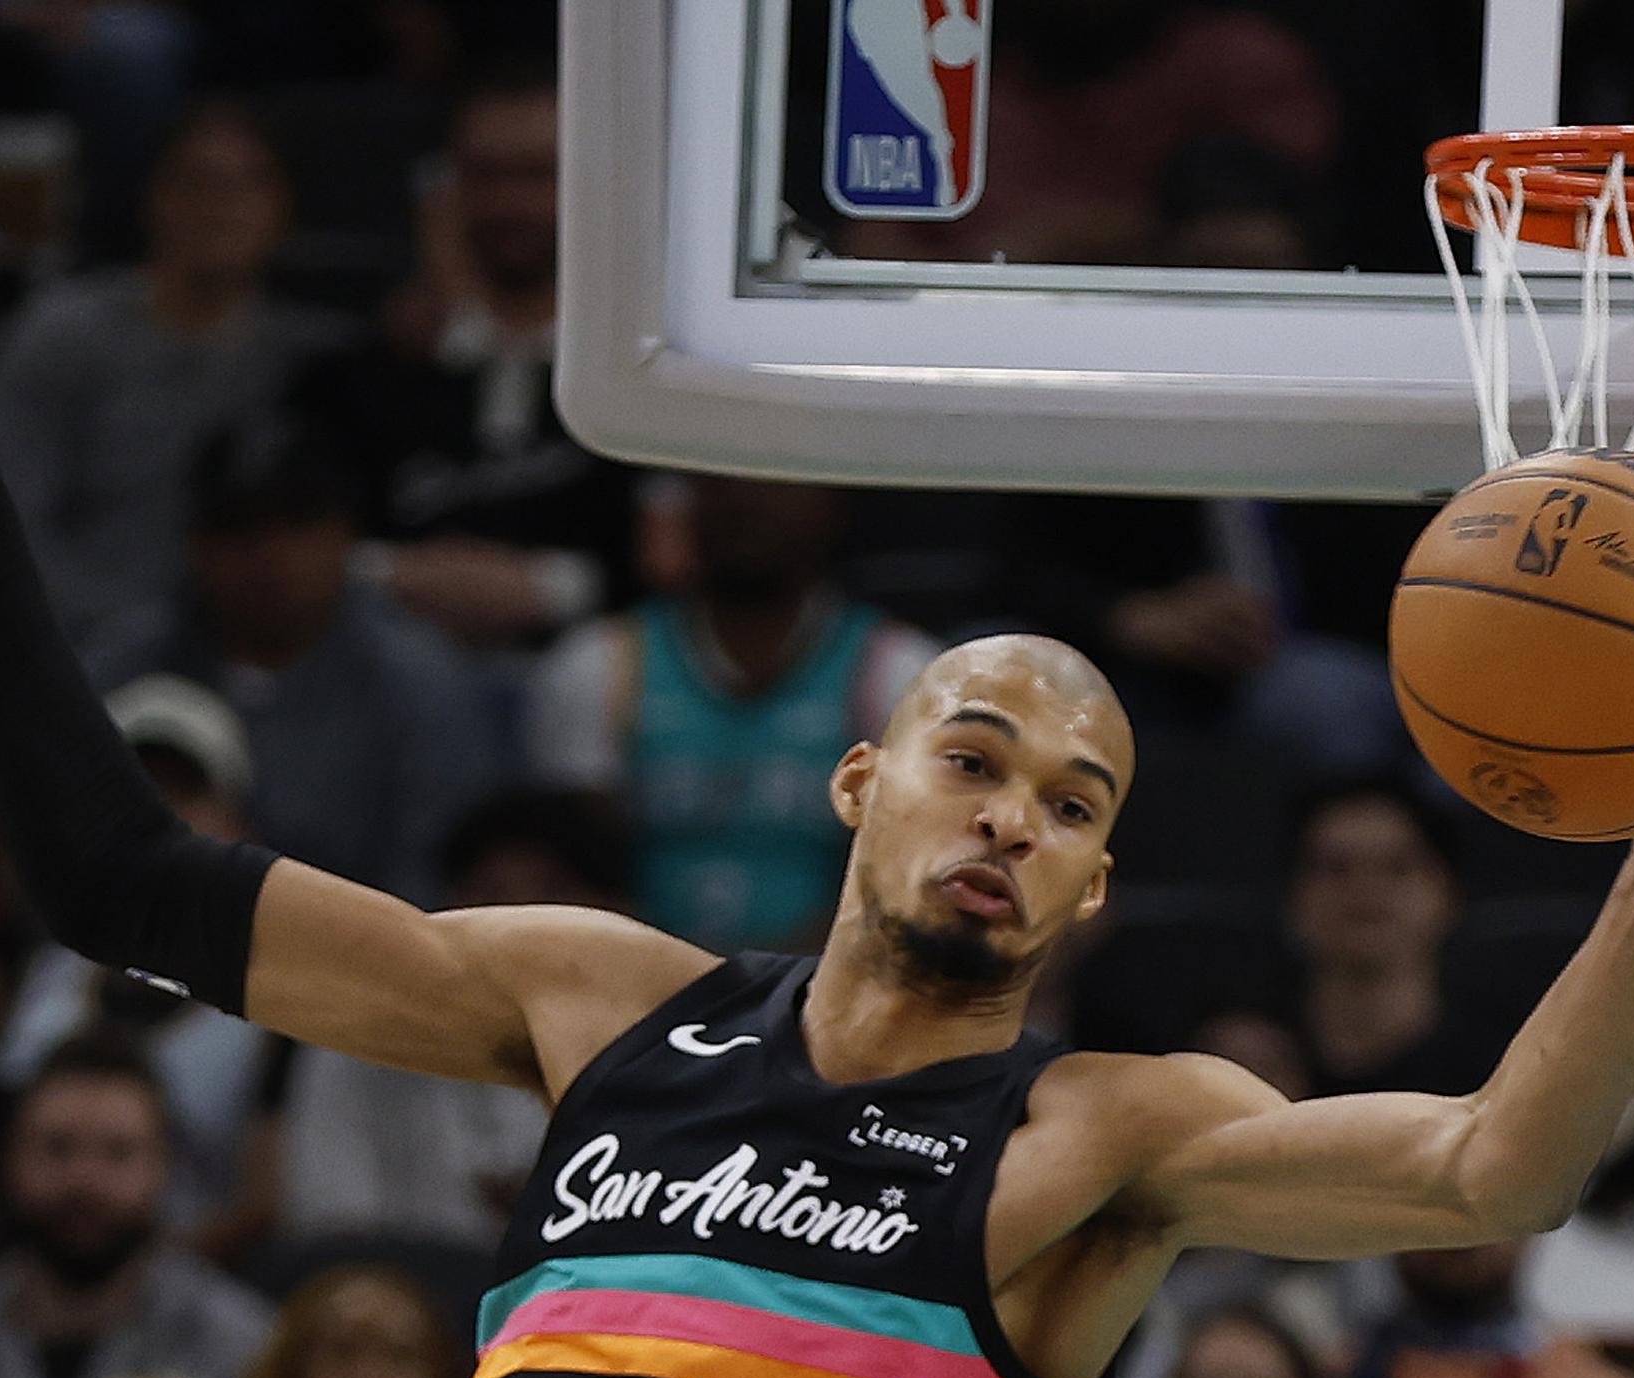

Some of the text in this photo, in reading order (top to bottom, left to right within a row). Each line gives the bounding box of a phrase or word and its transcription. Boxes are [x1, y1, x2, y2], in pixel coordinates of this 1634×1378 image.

[847, 133, 923, 192] NBA
[541, 1133, 919, 1254] San Antonio
